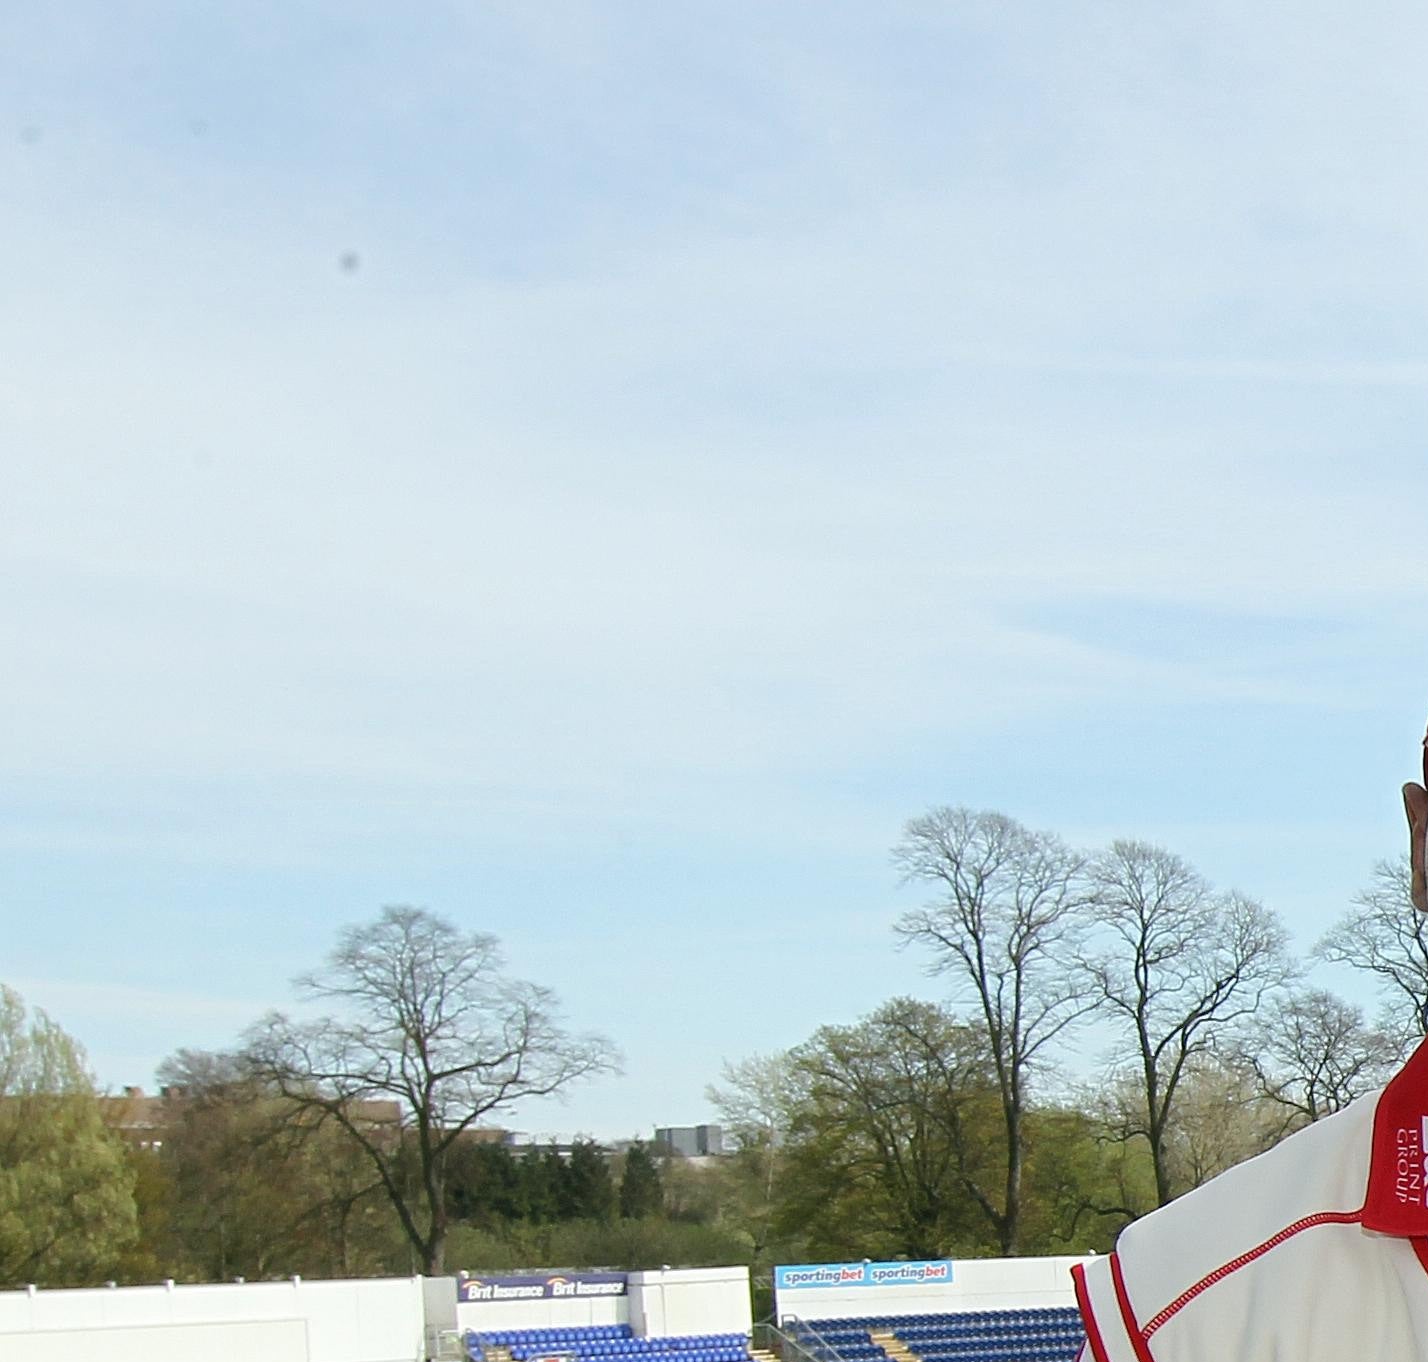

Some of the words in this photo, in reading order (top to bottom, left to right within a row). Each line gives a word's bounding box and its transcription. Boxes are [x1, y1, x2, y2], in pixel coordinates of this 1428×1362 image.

[1395, 1128, 1408, 1203] GROUP
[1408, 1129, 1420, 1205] PRINT
[785, 1268, 864, 1284] sportingbet
[871, 1265, 946, 1282] sportingbet
[468, 1284, 493, 1299] Brit
[493, 1283, 545, 1298] Insurance
[552, 1281, 576, 1296] Brit
[577, 1280, 625, 1294] Insurance
